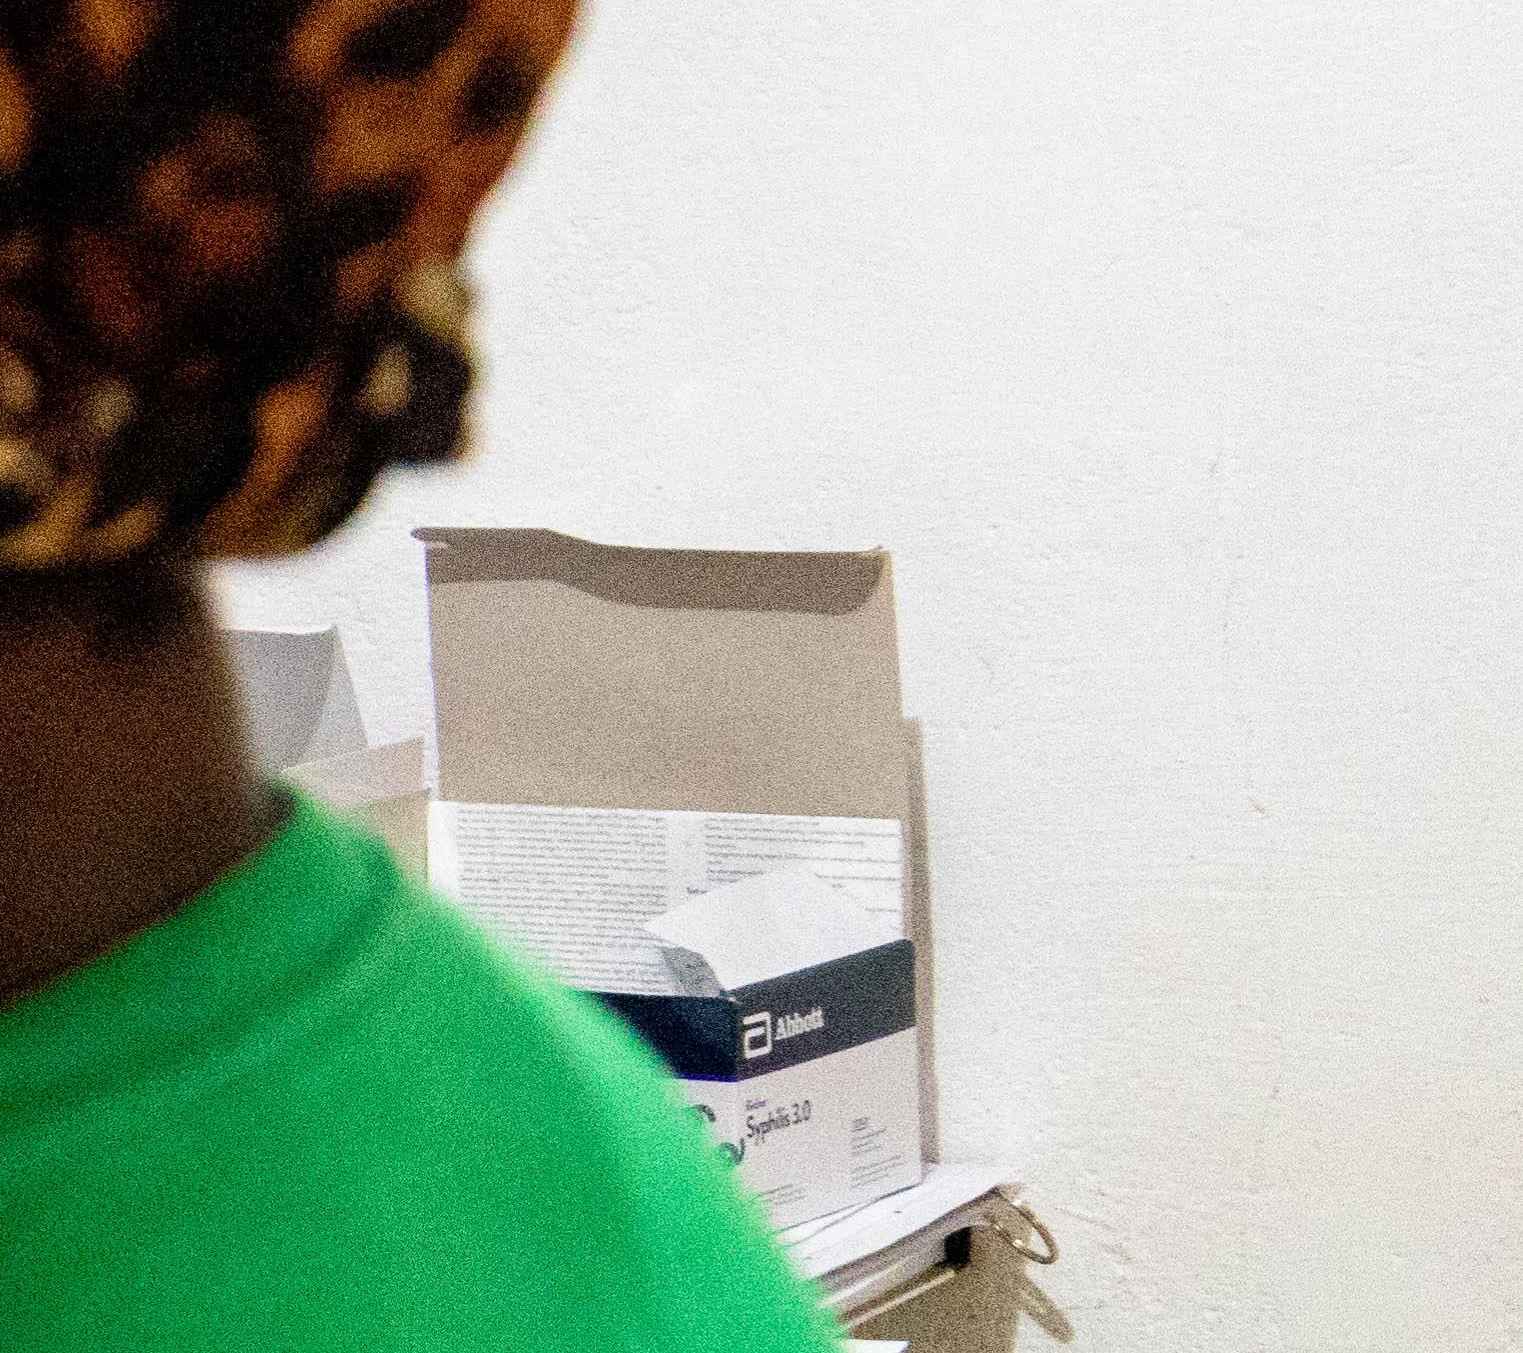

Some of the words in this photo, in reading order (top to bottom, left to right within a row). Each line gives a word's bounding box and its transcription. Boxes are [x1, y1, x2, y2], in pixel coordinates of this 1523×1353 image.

[774, 1005, 825, 1041] Abbott
[746, 1105, 791, 1146] Syphilis
[791, 1099, 813, 1125] 3.0
